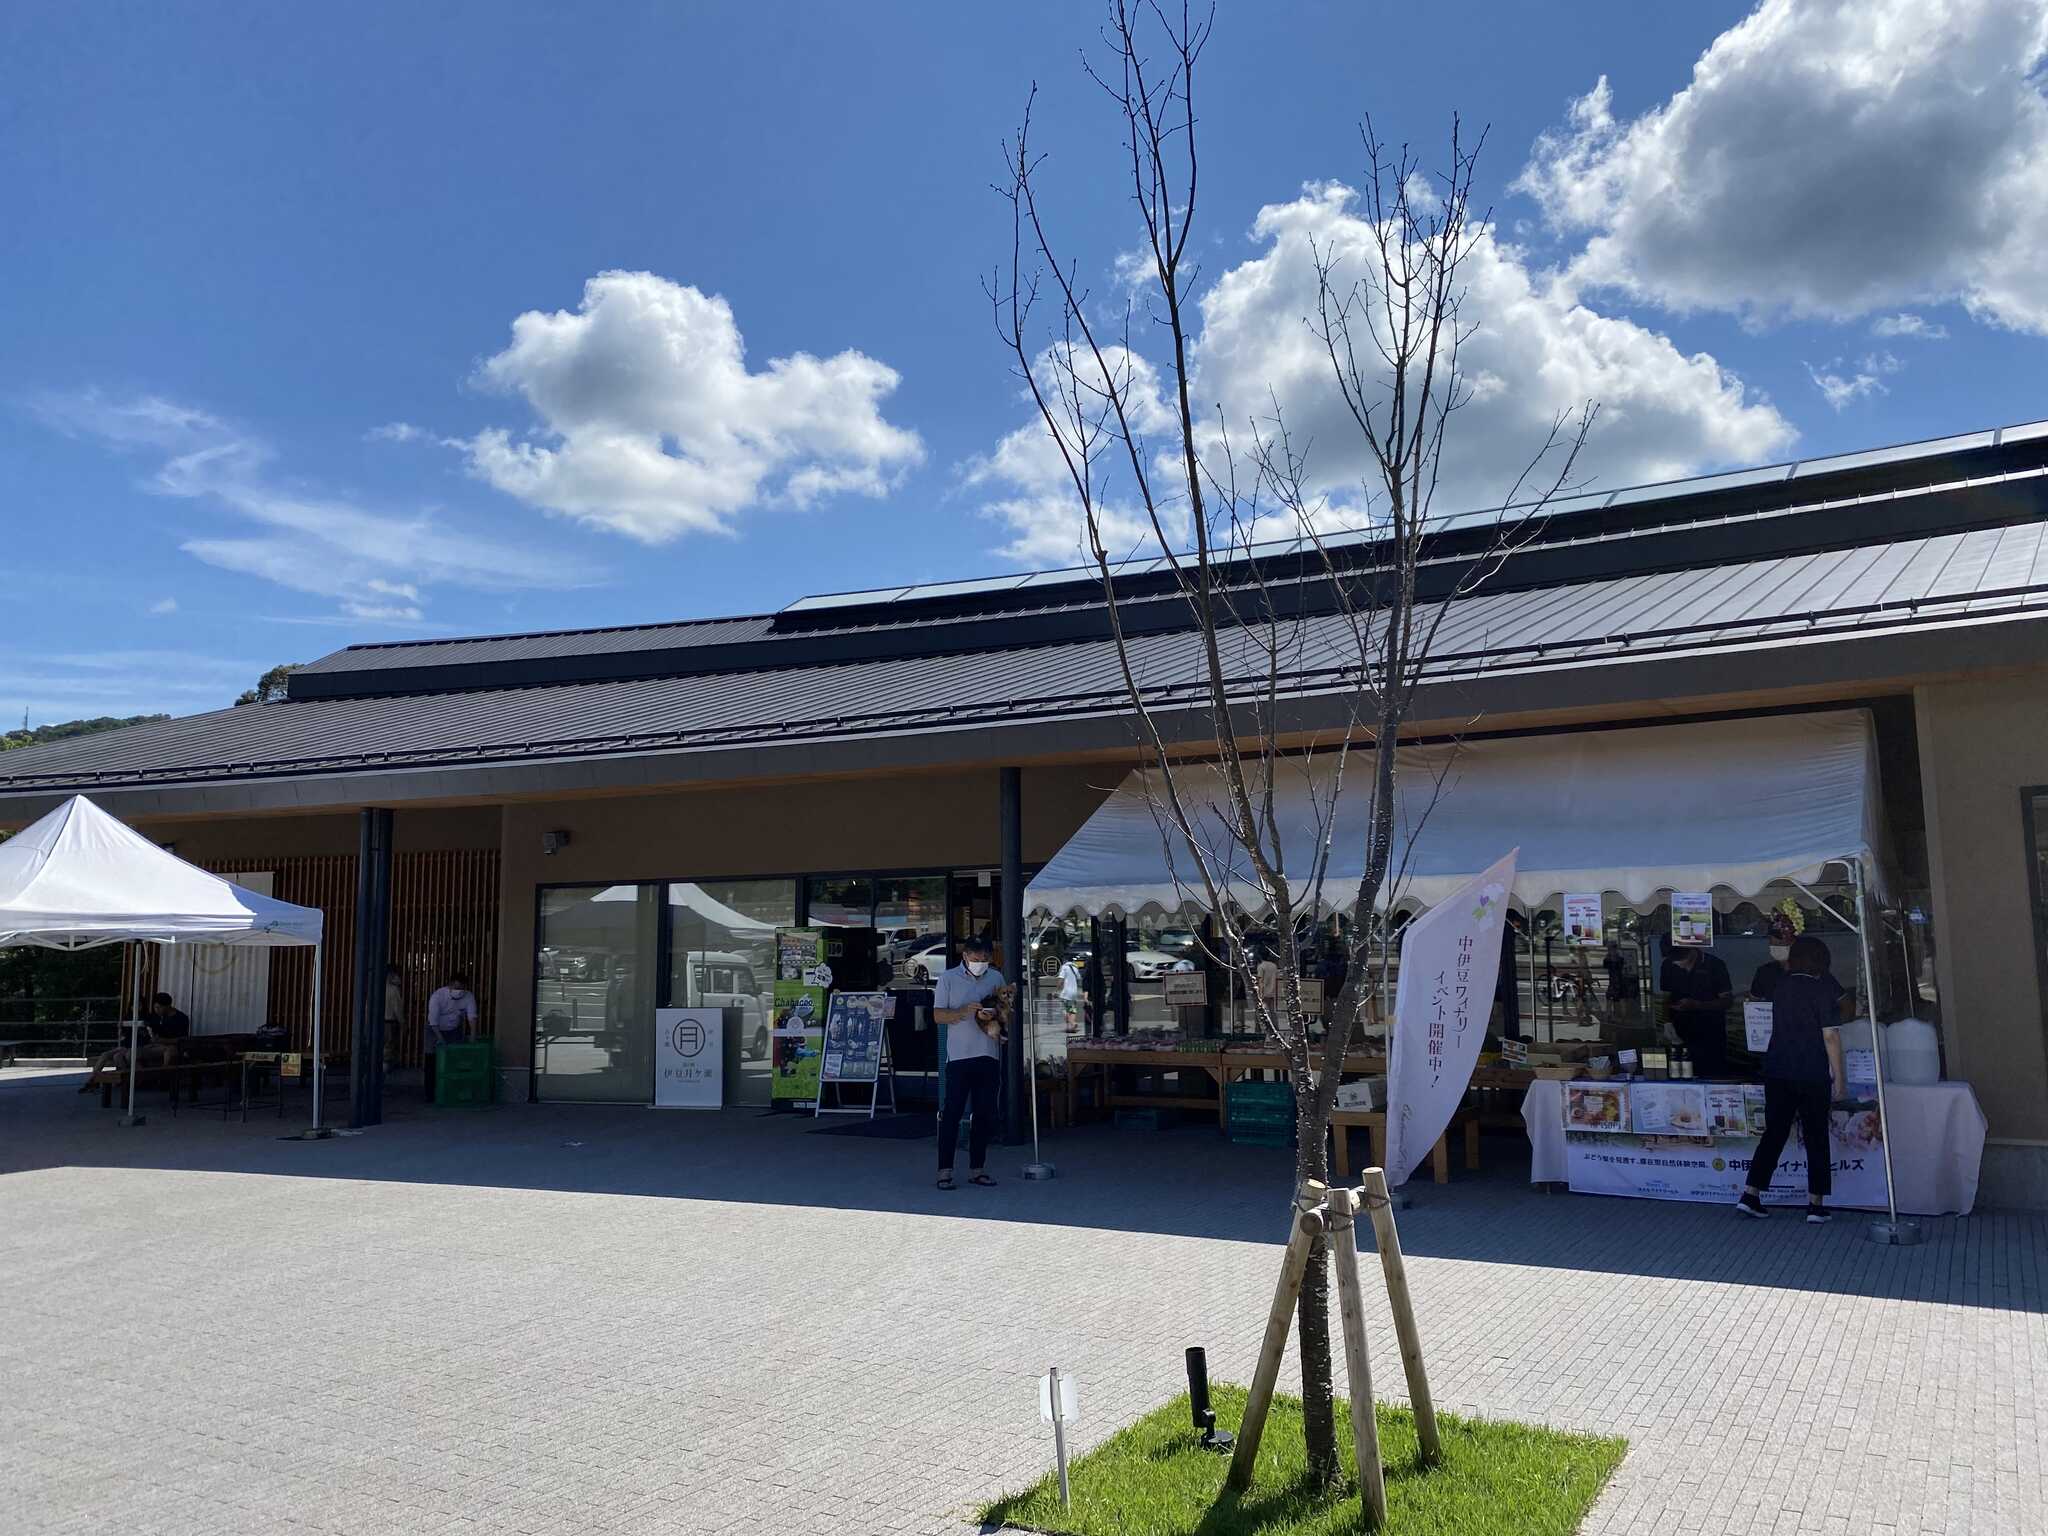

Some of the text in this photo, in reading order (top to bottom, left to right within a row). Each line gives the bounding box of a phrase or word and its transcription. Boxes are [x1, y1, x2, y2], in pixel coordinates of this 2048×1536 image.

[1453, 935, 1473, 1049] 中伊豆ワイナリー
